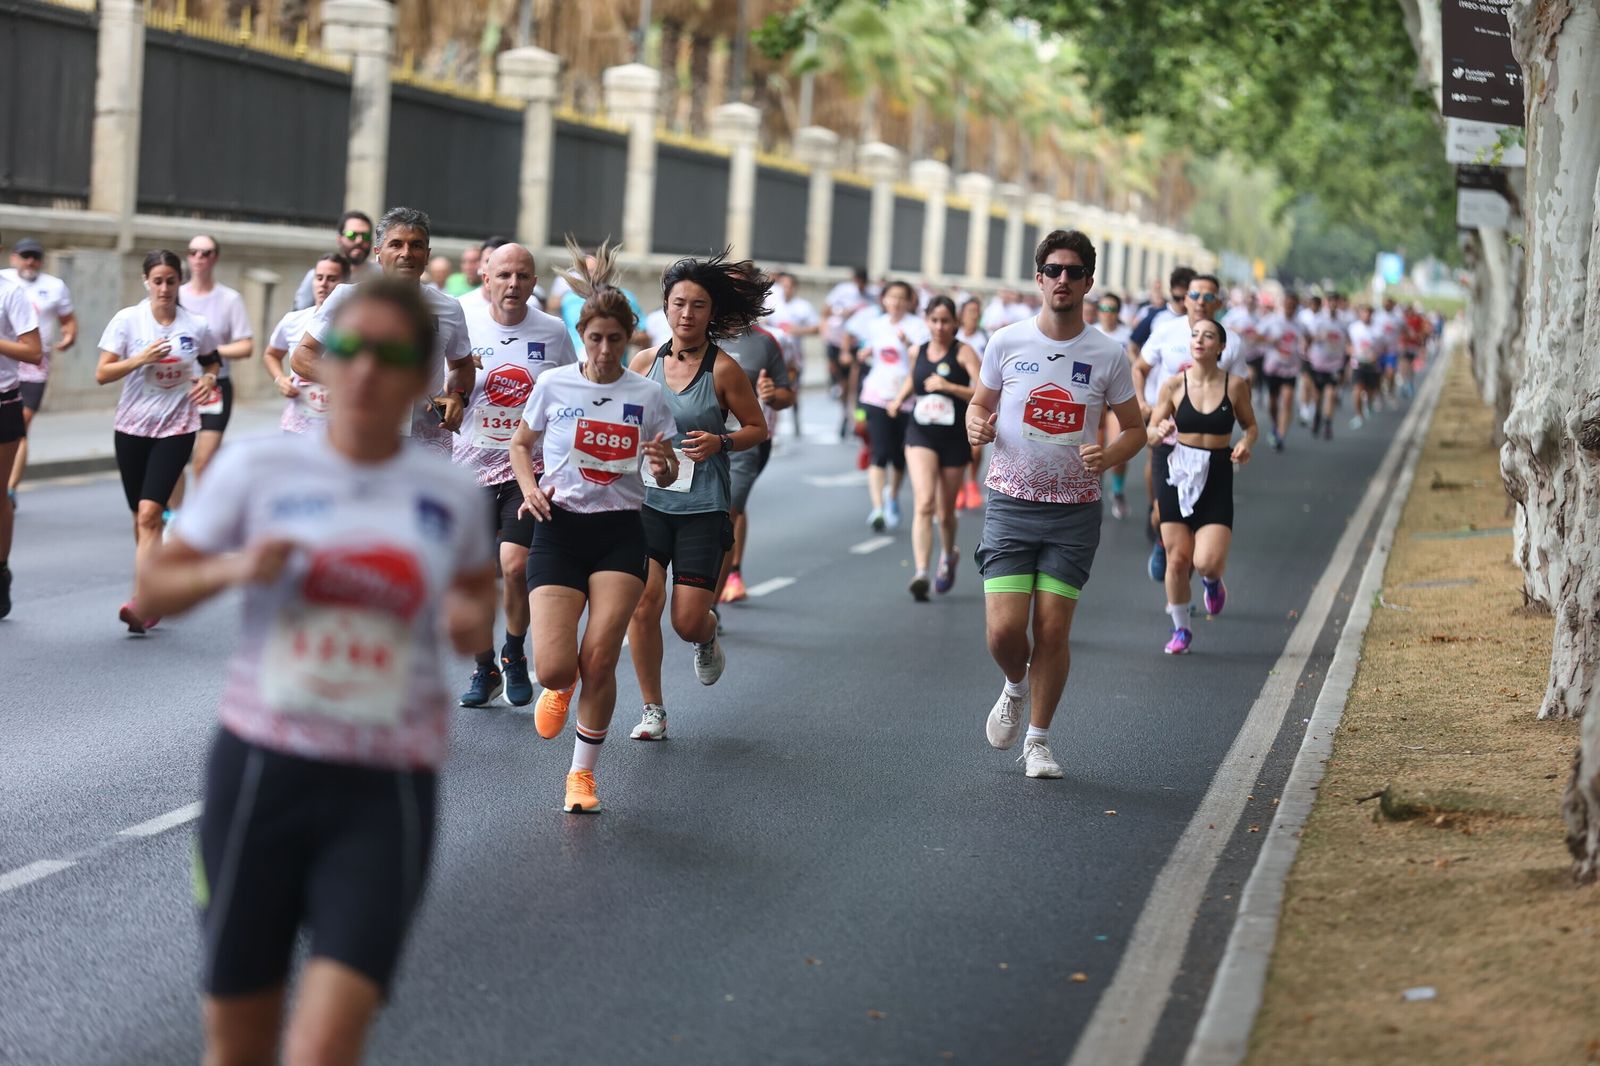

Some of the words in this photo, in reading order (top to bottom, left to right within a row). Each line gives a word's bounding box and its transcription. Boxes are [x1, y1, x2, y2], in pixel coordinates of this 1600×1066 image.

[156, 371, 182, 380] 943
[493, 374, 529, 391] PONLE
[490, 383, 524, 399] FRENO
[482, 417, 521, 430] 1344
[1031, 407, 1076, 425] 2441
[582, 430, 632, 450] 2689
